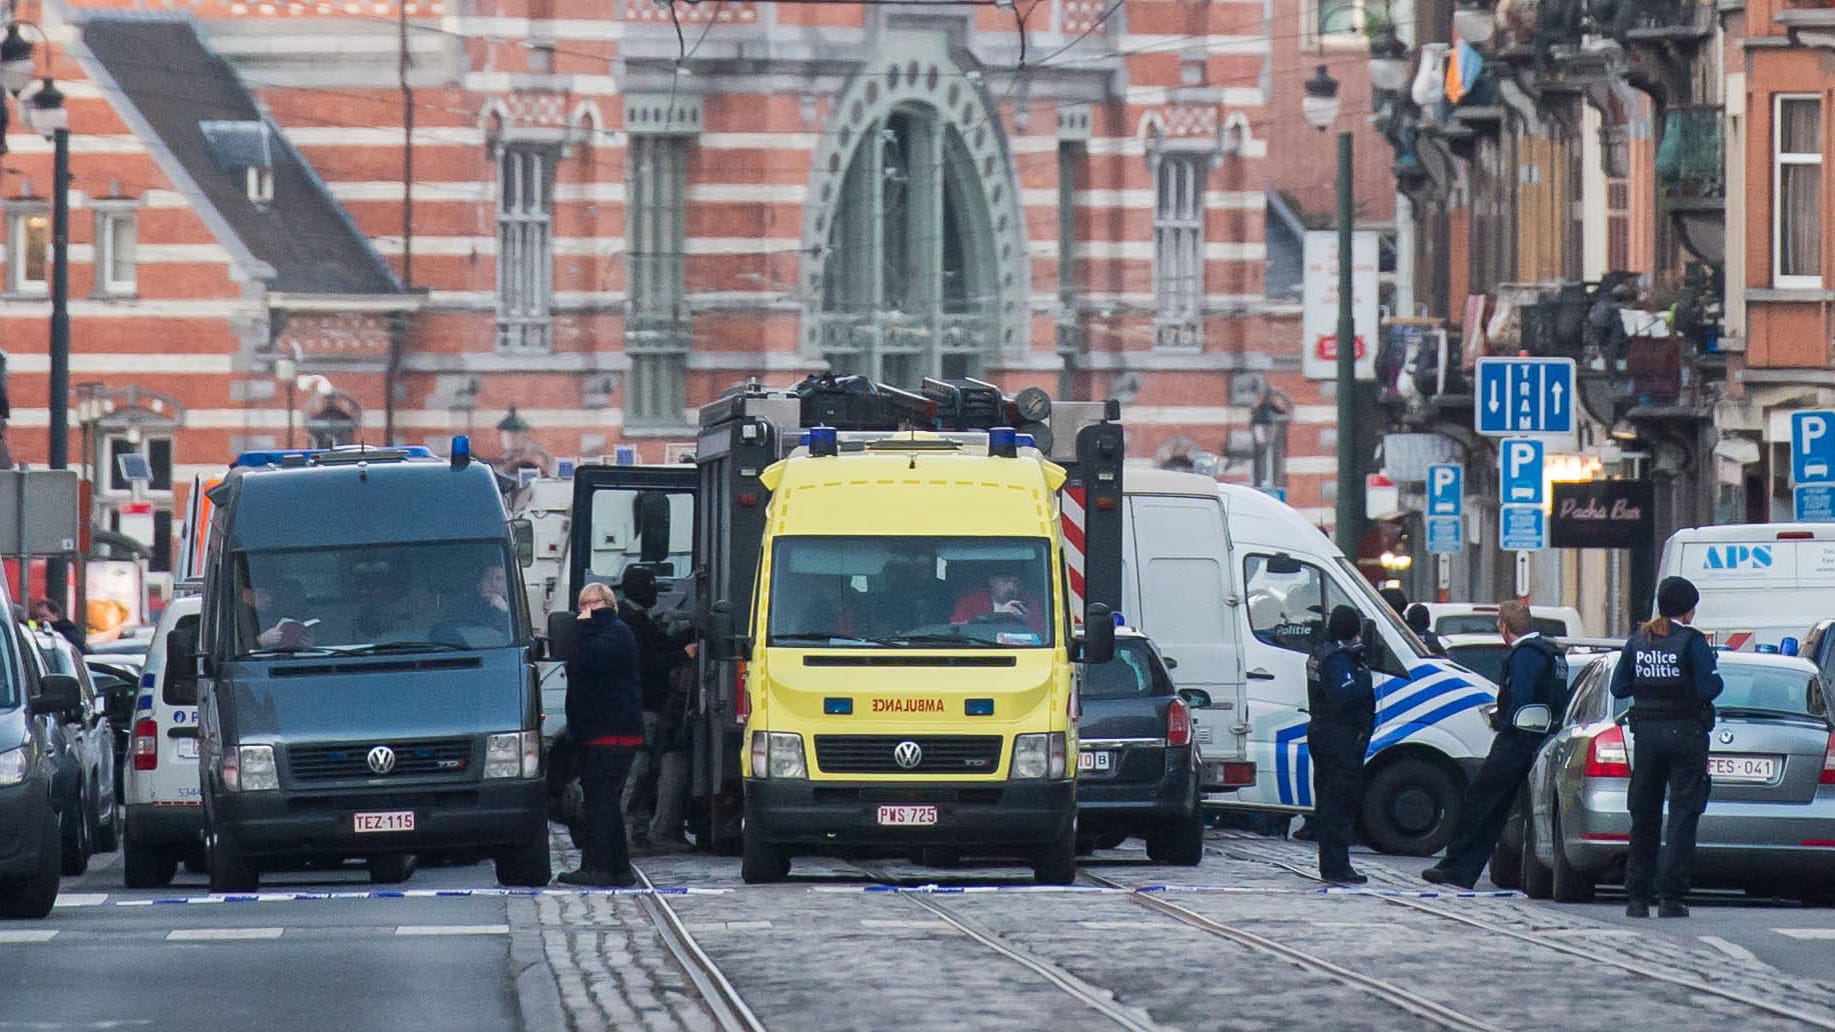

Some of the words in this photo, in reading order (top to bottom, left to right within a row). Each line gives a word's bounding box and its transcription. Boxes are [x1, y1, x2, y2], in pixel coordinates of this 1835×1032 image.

[1519, 364, 1531, 430] TRAM
[1802, 416, 1827, 455] P
[1511, 443, 1535, 478] P
[1434, 468, 1456, 497] P
[1702, 545, 1773, 569] APS
[1277, 625, 1312, 635] Politie
[1636, 650, 1677, 664] Police
[1635, 664, 1681, 677] Politie
